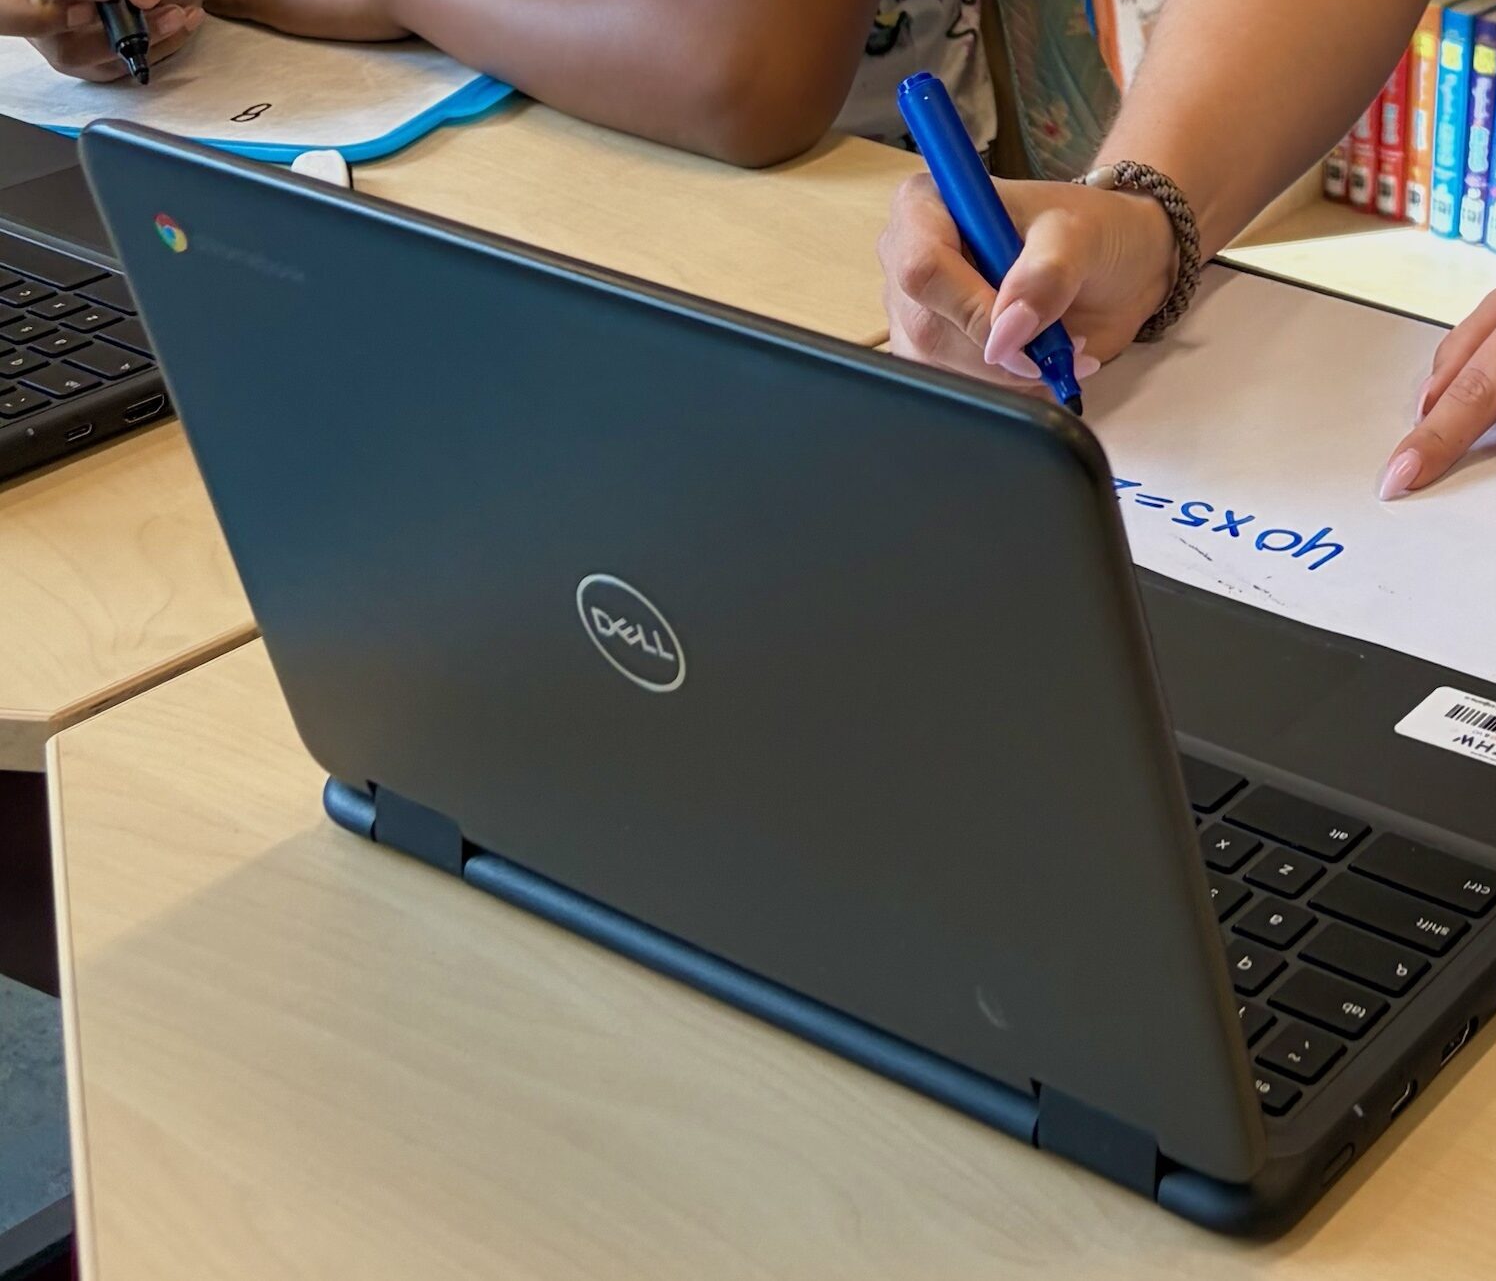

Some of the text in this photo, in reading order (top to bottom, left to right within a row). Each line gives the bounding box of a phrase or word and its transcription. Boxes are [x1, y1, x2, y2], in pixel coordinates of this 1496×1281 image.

[591, 606, 675, 661] DELL
[1329, 828, 1349, 841] alt
[1214, 838, 1231, 851] x
[1462, 880, 1491, 896] ctrl
[1415, 917, 1451, 936] shift
[1341, 1002, 1367, 1018] tab
